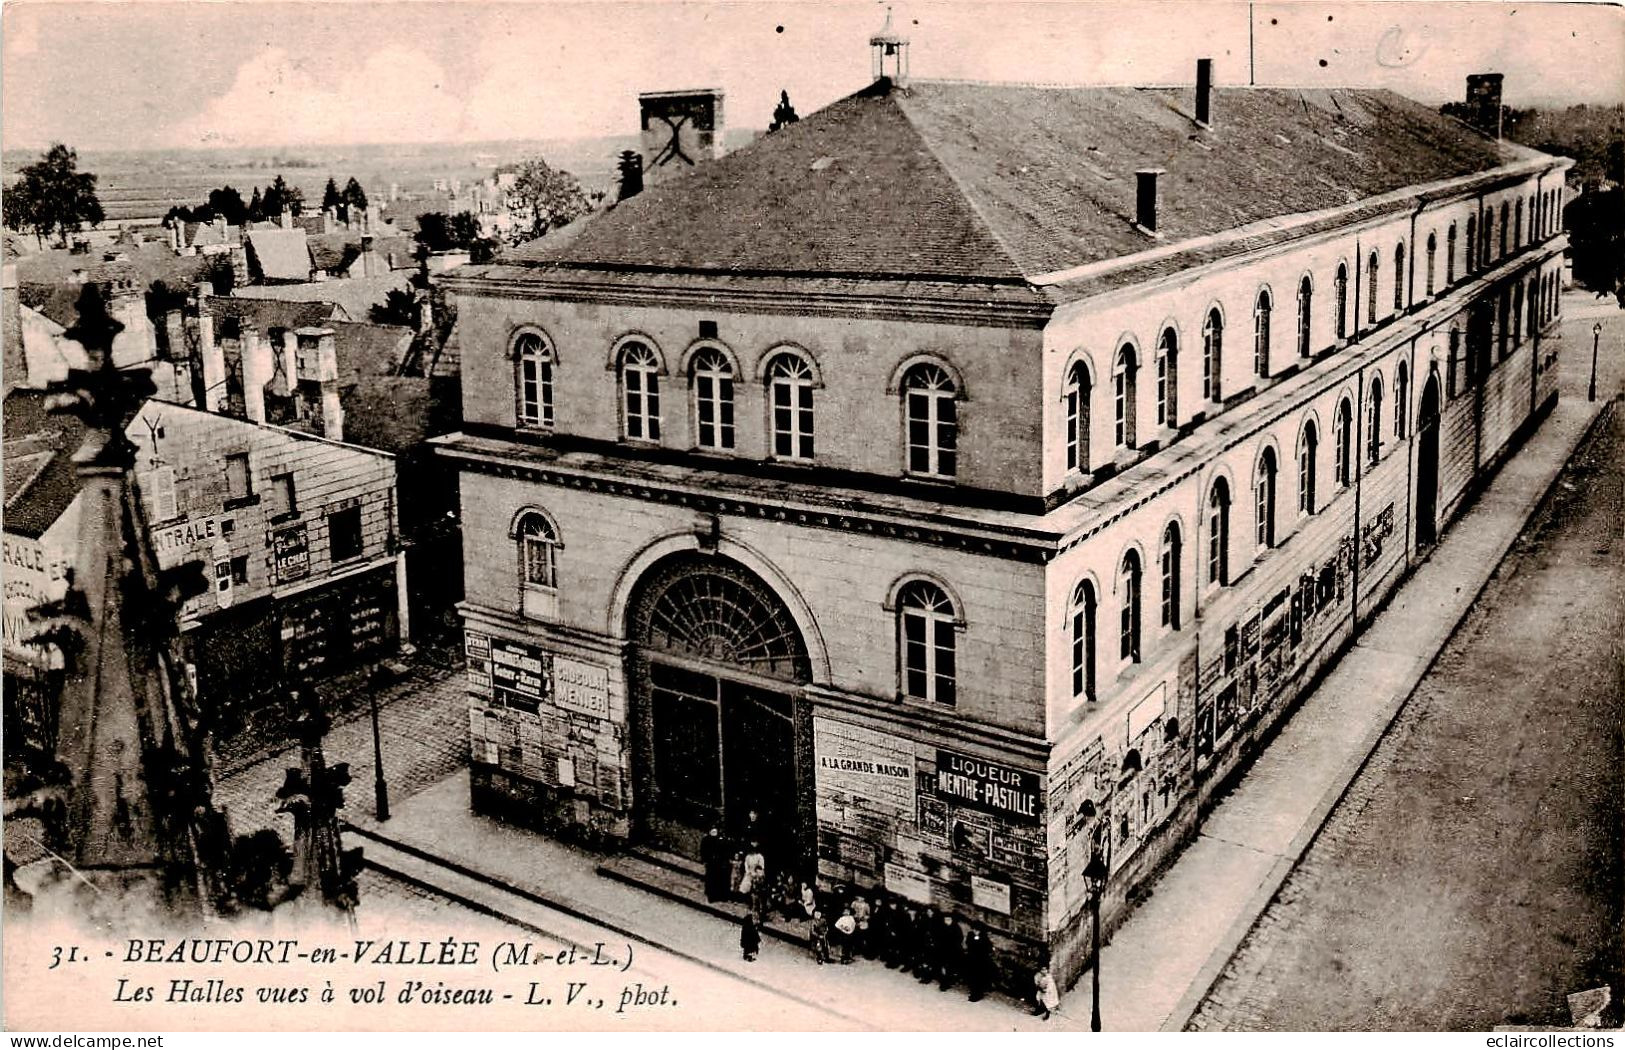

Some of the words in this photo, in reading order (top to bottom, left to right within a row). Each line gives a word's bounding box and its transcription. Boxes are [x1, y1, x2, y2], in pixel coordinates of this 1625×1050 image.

[829, 758, 840, 770] LA
[841, 759, 875, 774] GRANDE
[876, 763, 910, 778] MAISON
[951, 756, 1022, 787] LIQUEUR
